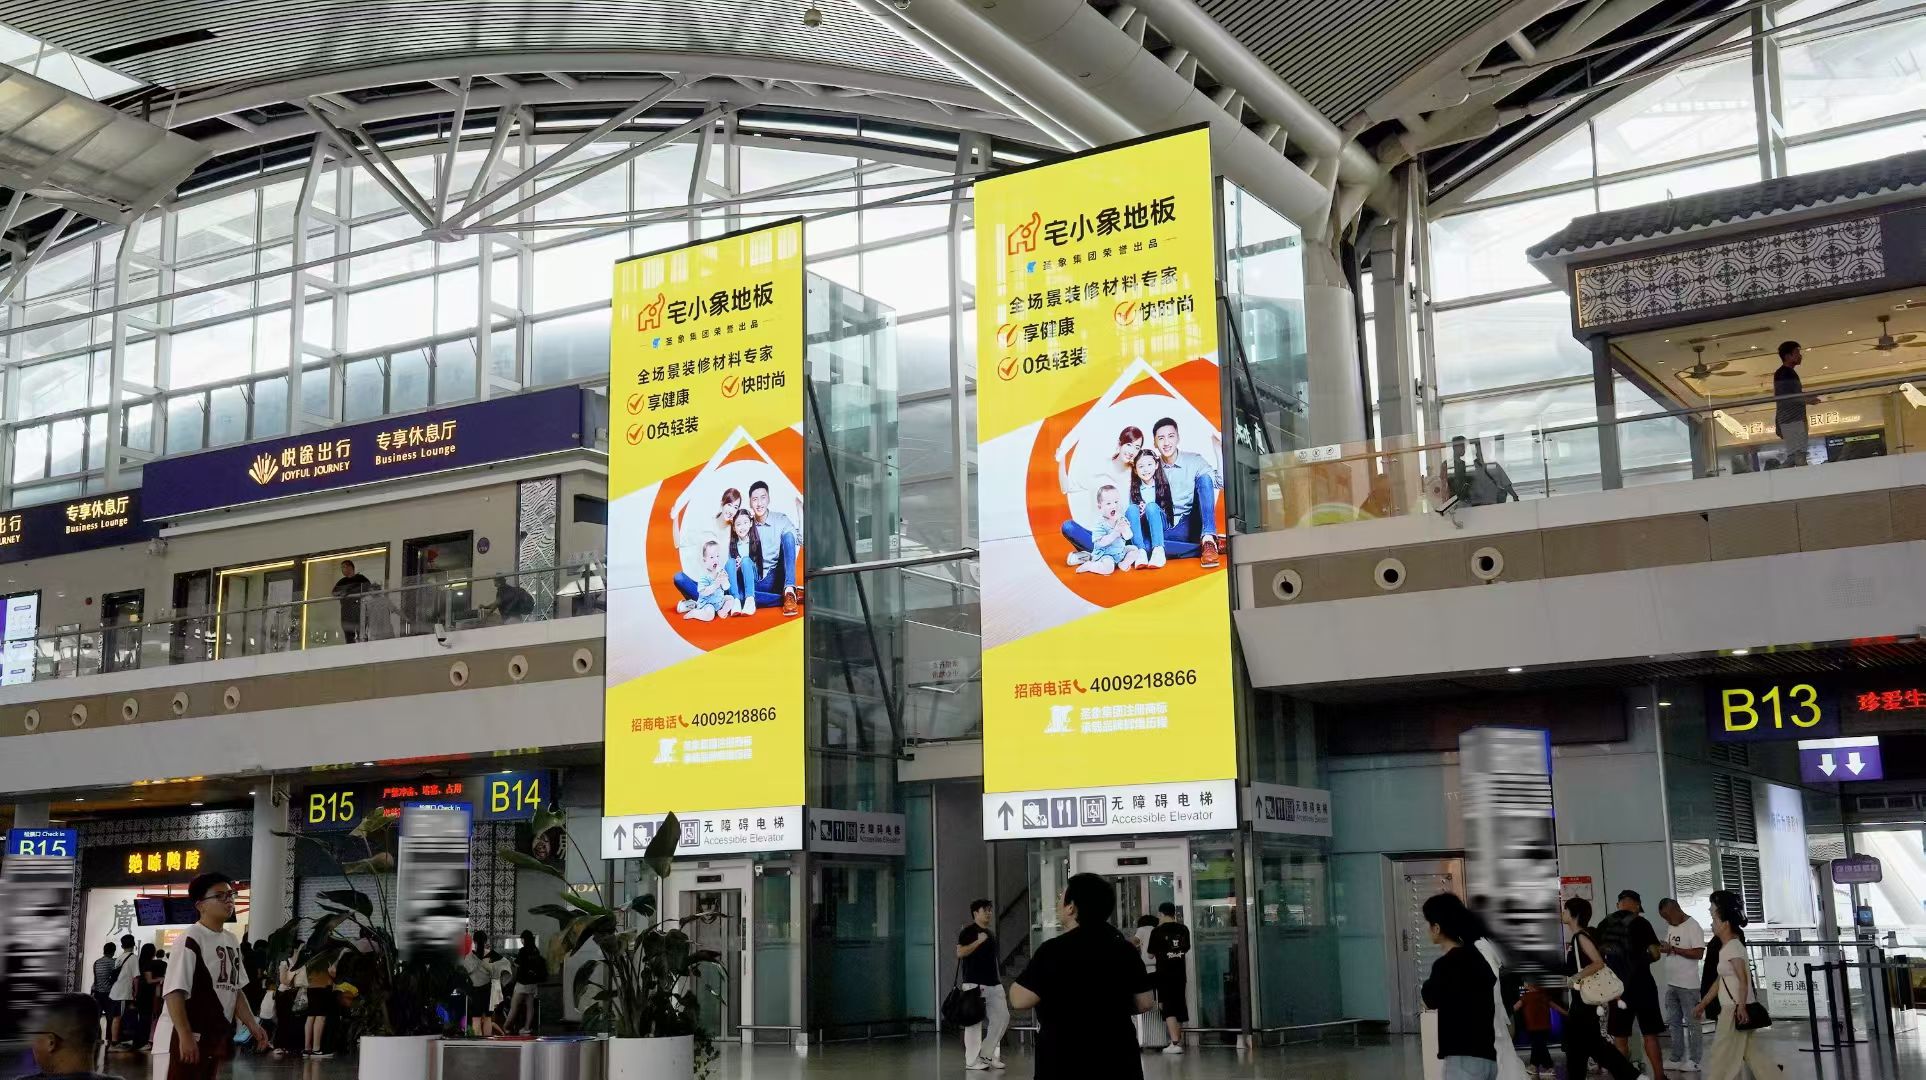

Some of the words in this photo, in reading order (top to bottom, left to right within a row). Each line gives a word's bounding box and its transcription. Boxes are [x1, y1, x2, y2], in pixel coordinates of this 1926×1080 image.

[1044, 195, 1177, 247] 宅小象地板
[1043, 238, 1158, 271] 圣象集团荣誉出品
[667, 280, 774, 325] 宅小象地板
[1009, 266, 1178, 315] 全场景装修材料专家
[1140, 294, 1195, 322] 快时尚
[665, 319, 759, 346] 圣象集团荣誉出品
[1022, 316, 1075, 343] 享健康
[637, 344, 774, 385] 全场景装修材料专家
[1022, 347, 1088, 374] 0负轻装
[741, 370, 786, 395] 快时尚
[647, 388, 690, 412] 享健康
[376, 419, 457, 450] 专享休息厅
[646, 416, 699, 440] 0负轻装
[281, 438, 351, 467] 悦途出行
[375, 451, 417, 466] Business
[421, 444, 456, 458] Lounge
[281, 468, 311, 483] JOYFUL
[313, 460, 351, 477] JOURNEY
[66, 496, 129, 522] 专享休息厅
[65, 522, 98, 535] Business
[100, 517, 128, 530] Lounge
[1014, 680, 1072, 699] 招商电话
[1089, 669, 1198, 694] 4009218866
[631, 715, 677, 732] 招商电话
[691, 706, 777, 727] 4009218866
[1722, 684, 1822, 732] B13
[308, 791, 355, 823] B15
[491, 778, 541, 813] B14
[1111, 791, 1213, 811] 无障碍电梯
[704, 816, 784, 833] 无障碍电梯
[1111, 811, 1167, 824] Accessible
[1169, 810, 1213, 822] Elevator
[20, 840, 66, 857] B15
[704, 834, 748, 845] Accessible
[749, 832, 784, 843] Elevator
[106, 899, 136, 936] 廣
